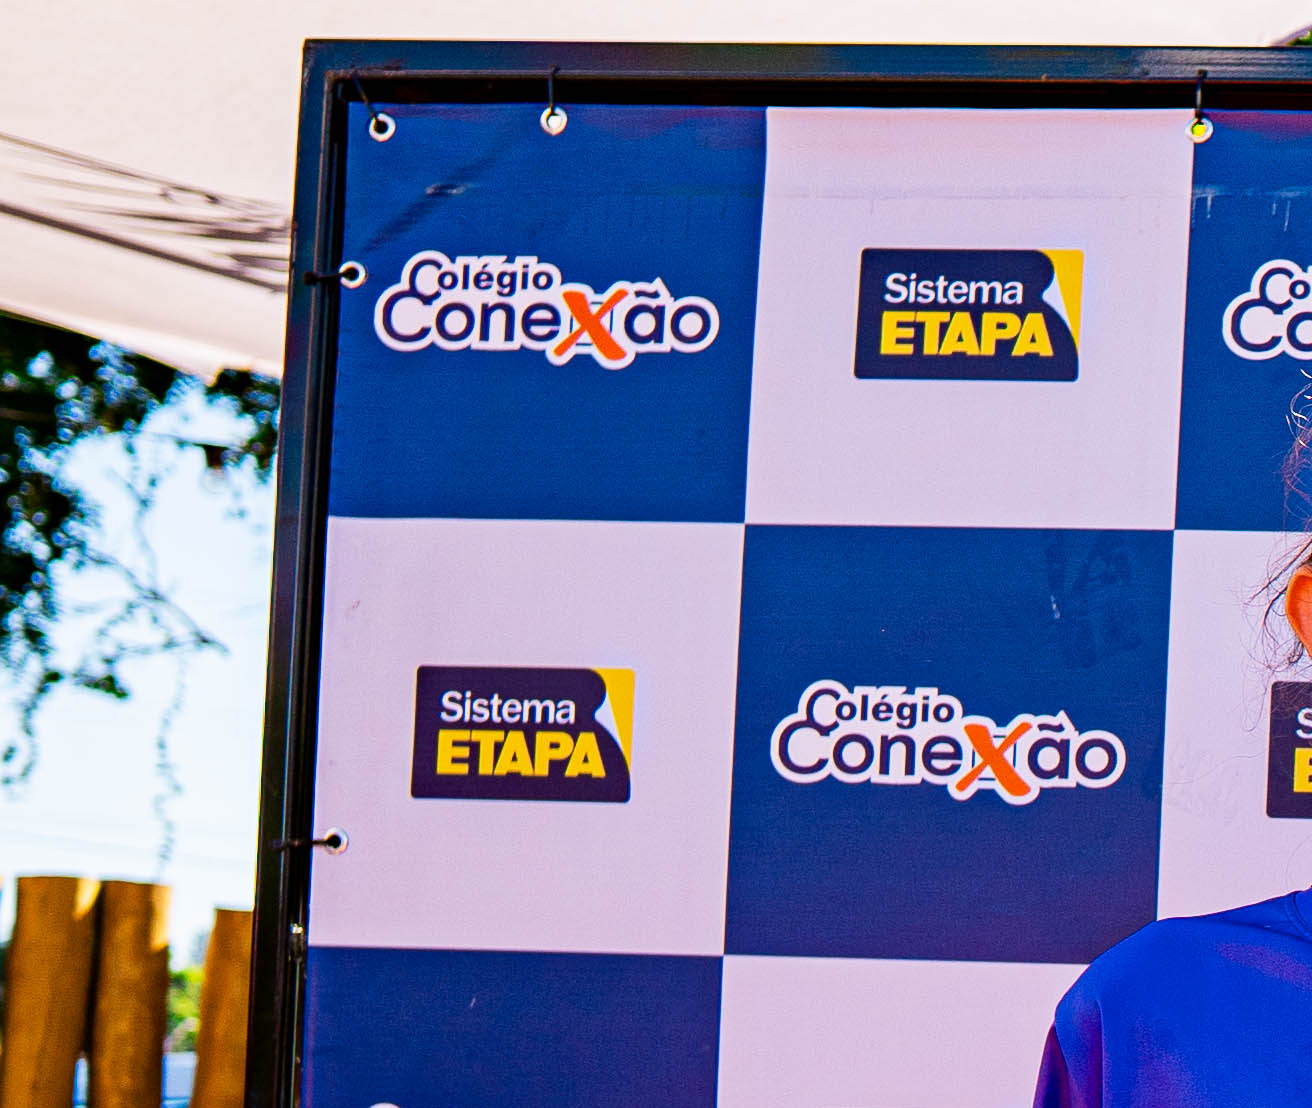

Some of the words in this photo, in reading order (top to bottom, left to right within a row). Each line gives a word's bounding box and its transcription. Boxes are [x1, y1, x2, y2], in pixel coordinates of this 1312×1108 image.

[408, 259, 553, 298] Colégio
[884, 273, 1024, 305] Sistema
[880, 311, 1054, 357] ETAPA
[441, 691, 575, 725] Sistema
[806, 687, 955, 728] Colégio
[435, 730, 606, 778] ETAPA
